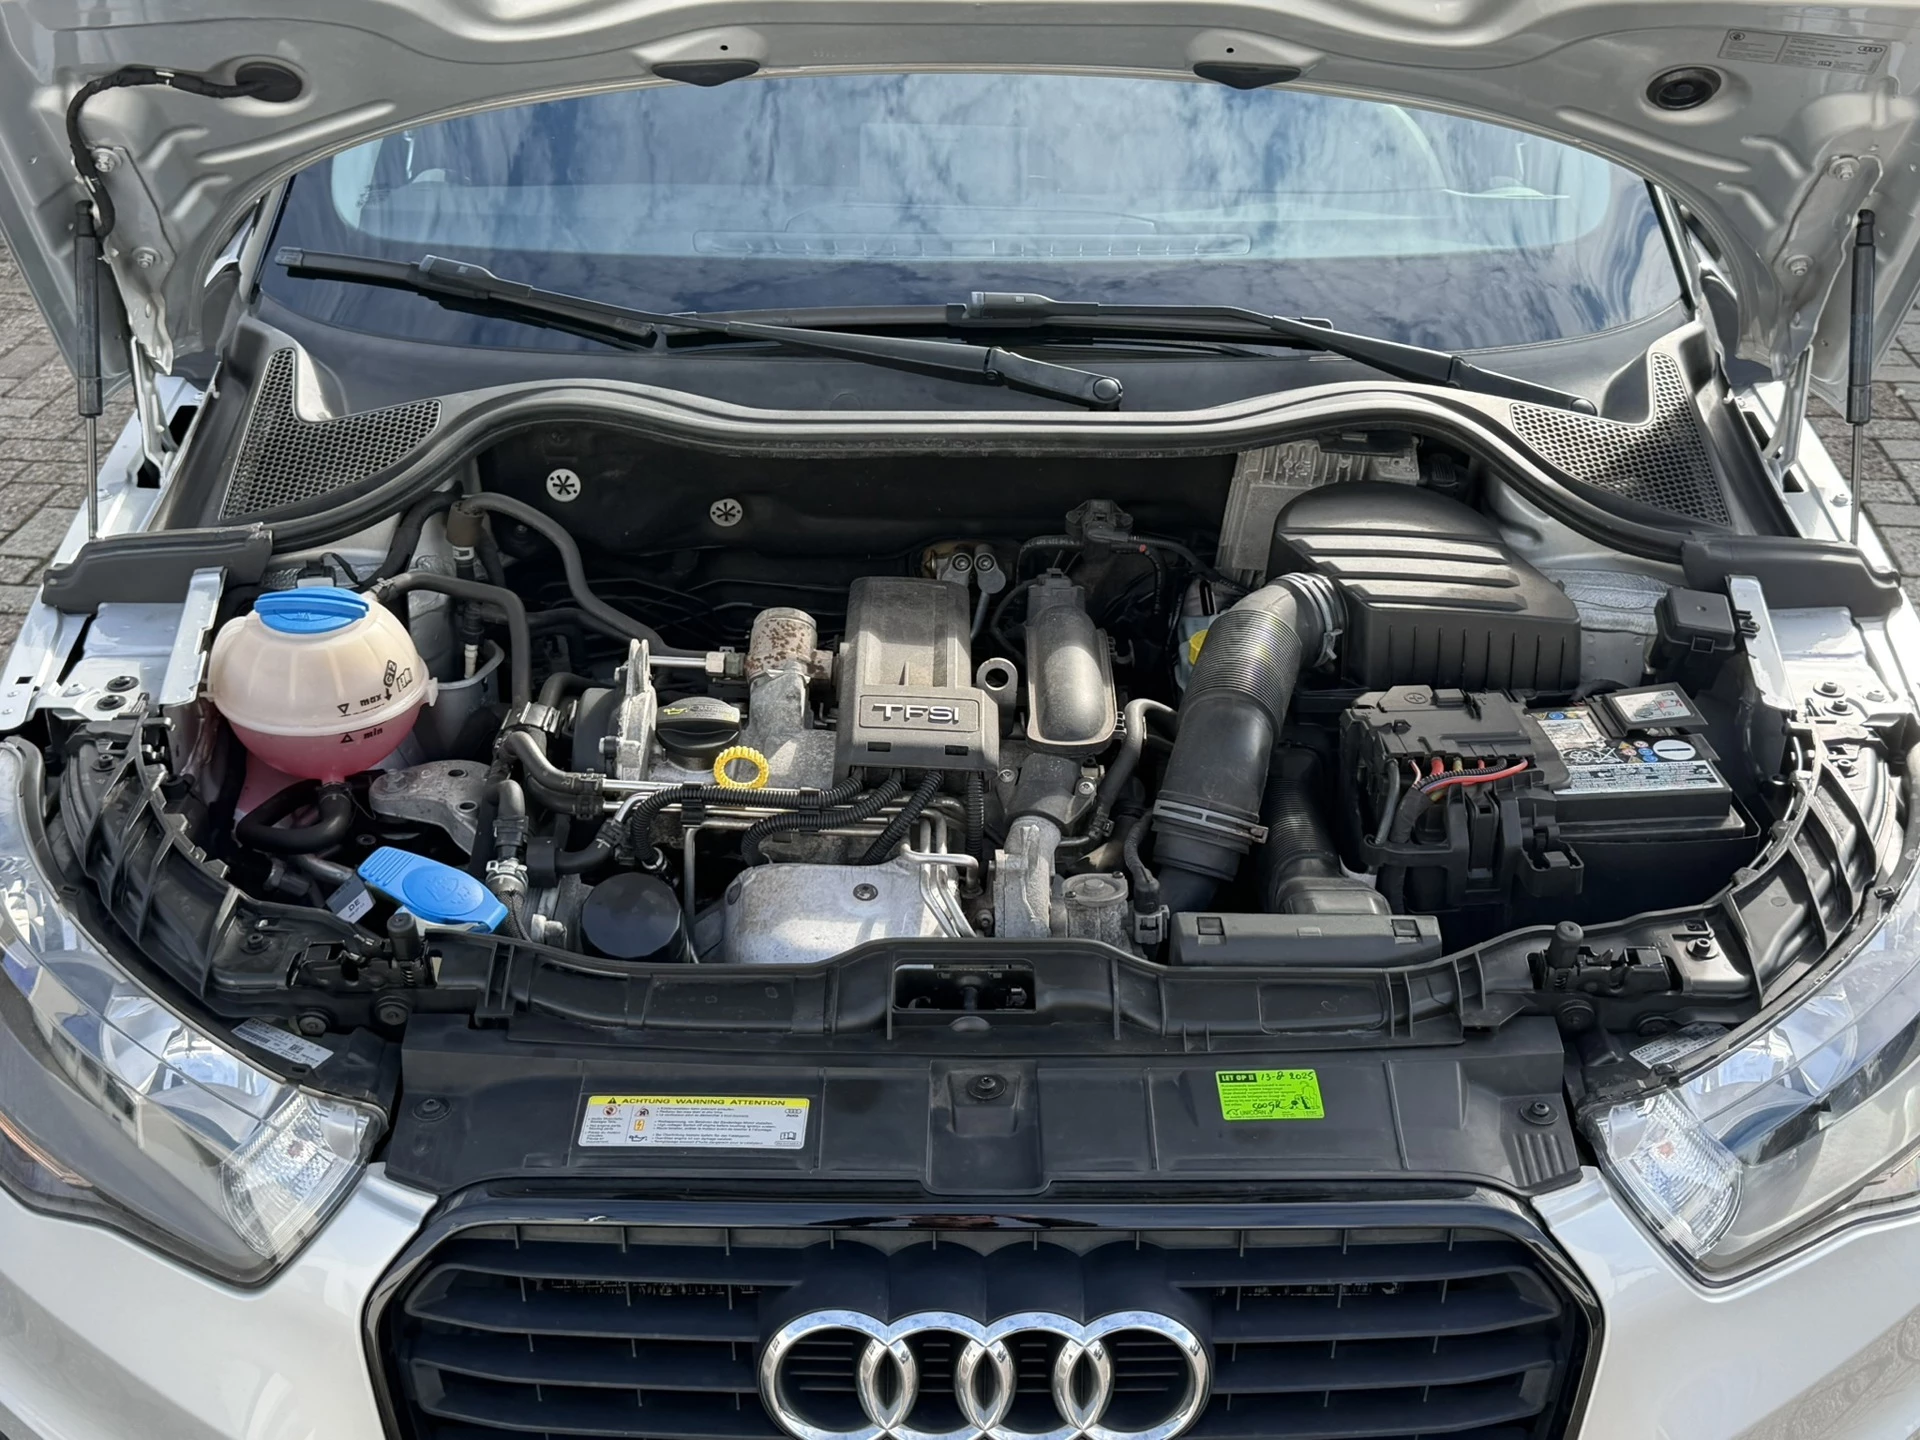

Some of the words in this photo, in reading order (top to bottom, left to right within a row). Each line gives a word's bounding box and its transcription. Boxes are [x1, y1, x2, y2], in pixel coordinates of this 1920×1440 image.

[385, 662, 396, 684] G12
[360, 694, 382, 707] max
[872, 703, 960, 724] TFSI
[363, 728, 383, 739] min
[1289, 1072, 1314, 1081] 2025
